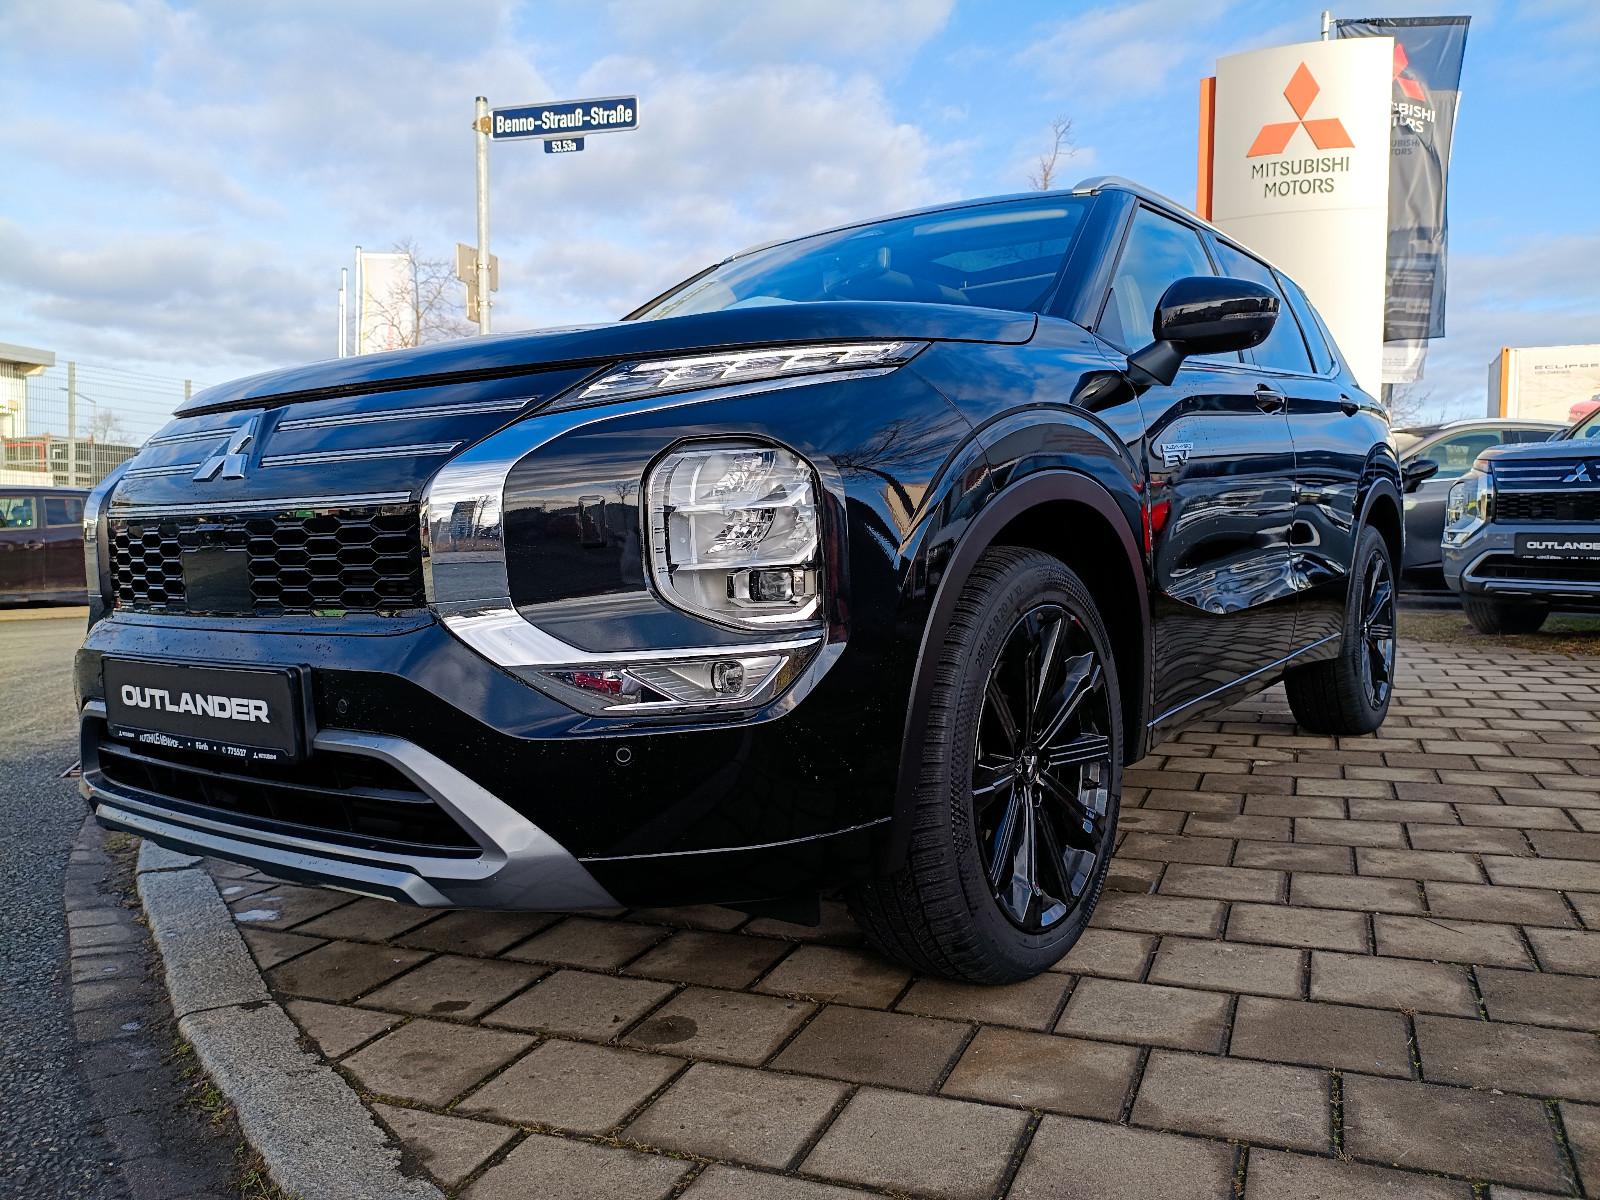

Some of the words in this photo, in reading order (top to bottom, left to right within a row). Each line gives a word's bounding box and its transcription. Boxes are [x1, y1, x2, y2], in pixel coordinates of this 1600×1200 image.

[496, 104, 633, 133] Benno-Strauß-Straße
[1252, 156, 1350, 180] MITSUBISHI
[1264, 177, 1335, 198] MOTORS
[1526, 541, 1600, 551] OUTLANDE
[121, 684, 271, 724] OUTLANDER
